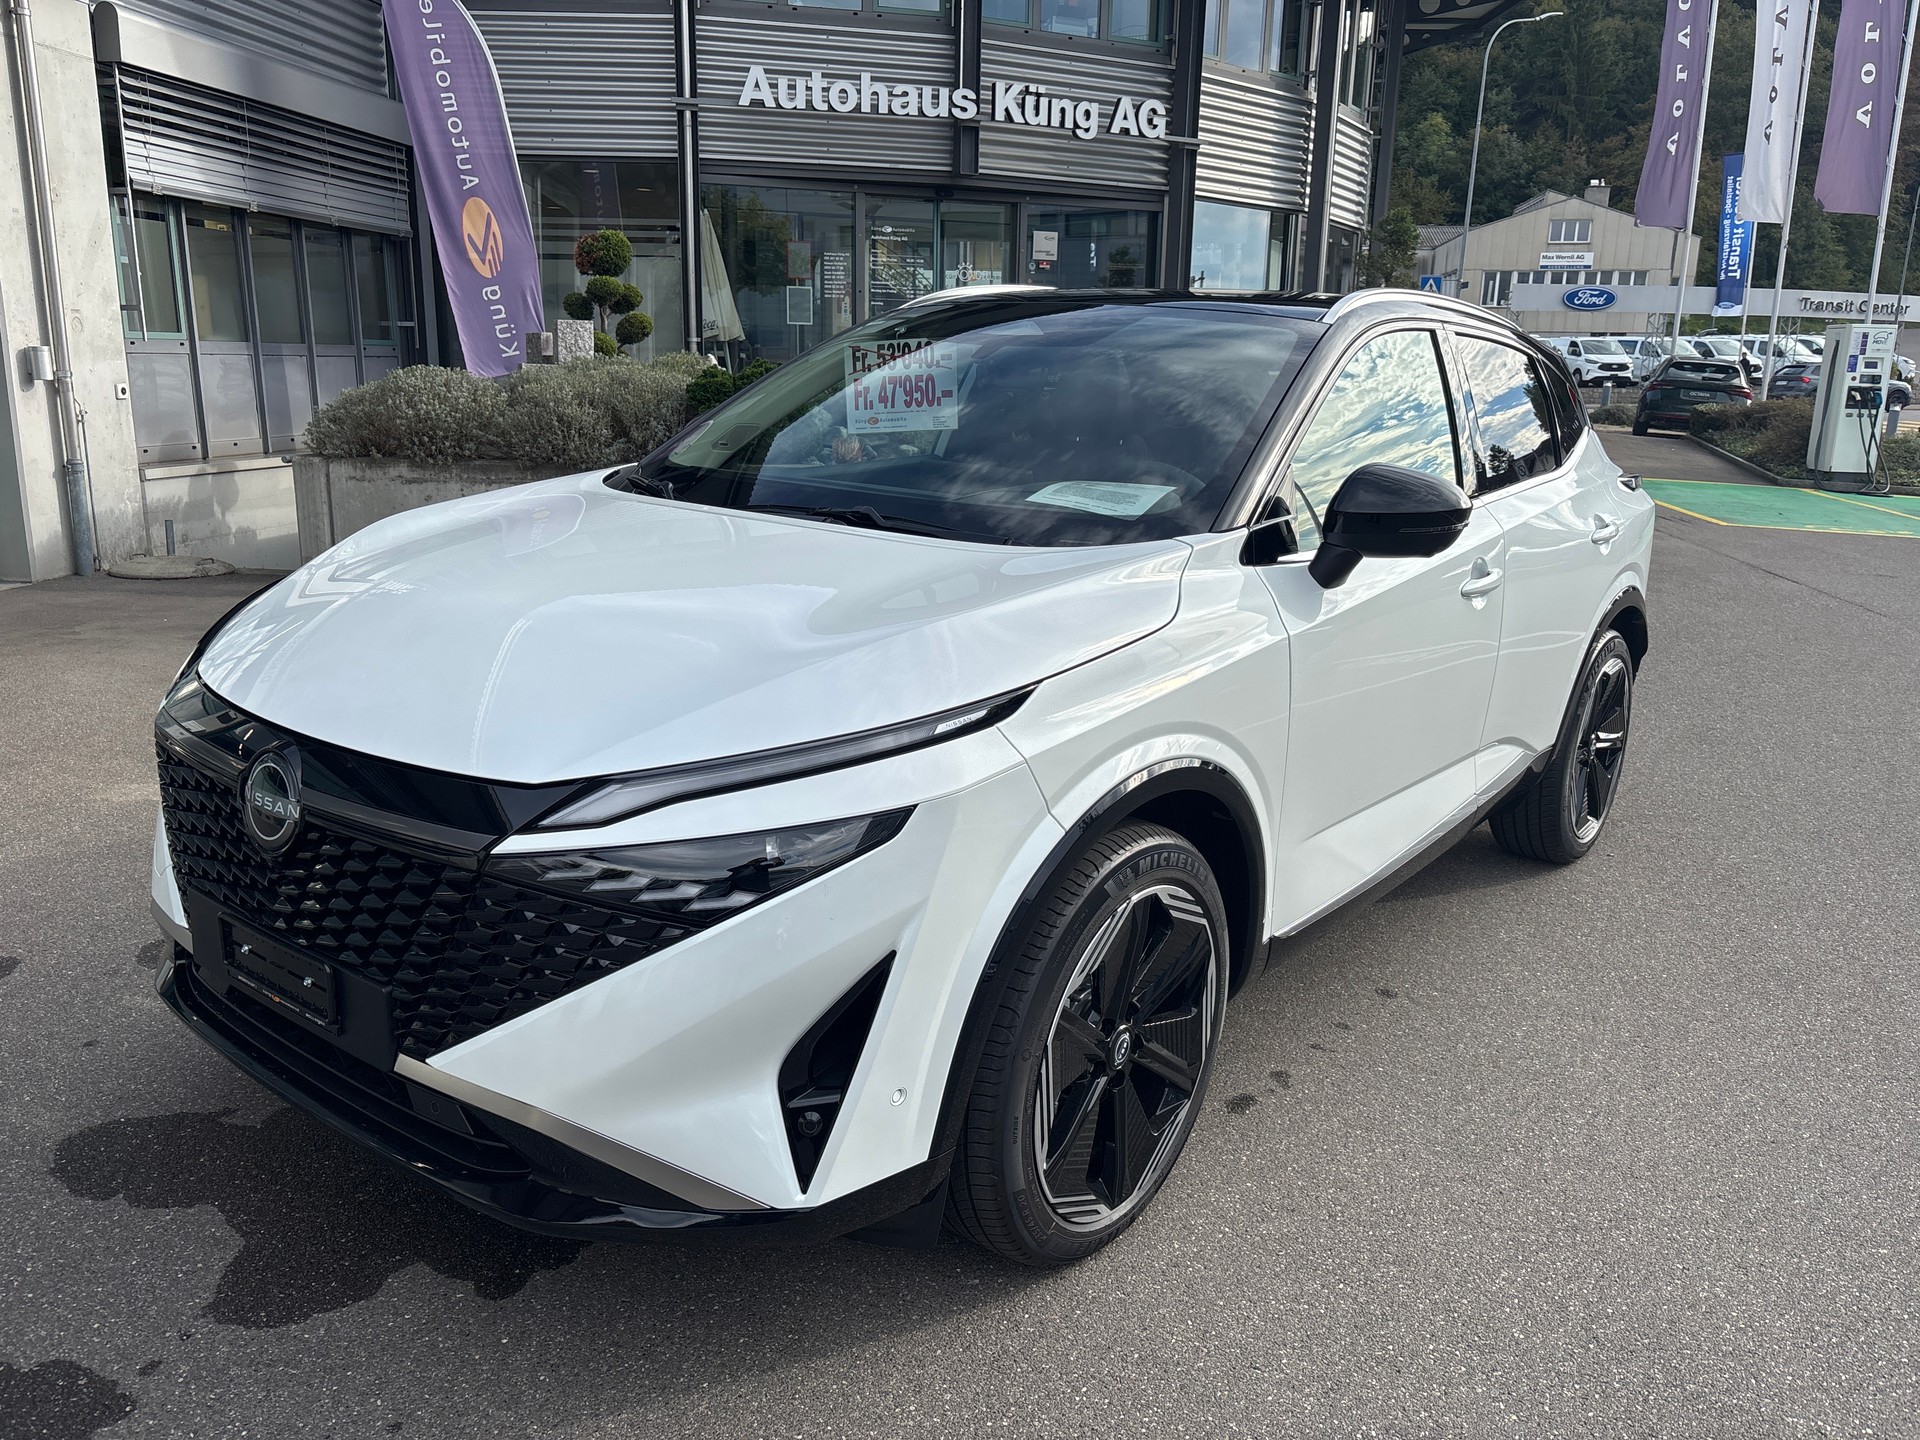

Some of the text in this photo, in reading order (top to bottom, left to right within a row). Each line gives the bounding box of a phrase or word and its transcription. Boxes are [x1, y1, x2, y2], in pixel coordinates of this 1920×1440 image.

[738, 65, 1166, 140] Autohaus Küng AG
[1574, 290, 1608, 304] Ford
[1801, 298, 1910, 314] Transit Center
[852, 346, 872, 373] Fr.
[854, 378, 874, 410] Fr.
[946, 716, 972, 728] NISSAN
[246, 784, 300, 818] NISSAN
[1138, 852, 1208, 881] MICHELIN
[1018, 1194, 1025, 1208] 20
